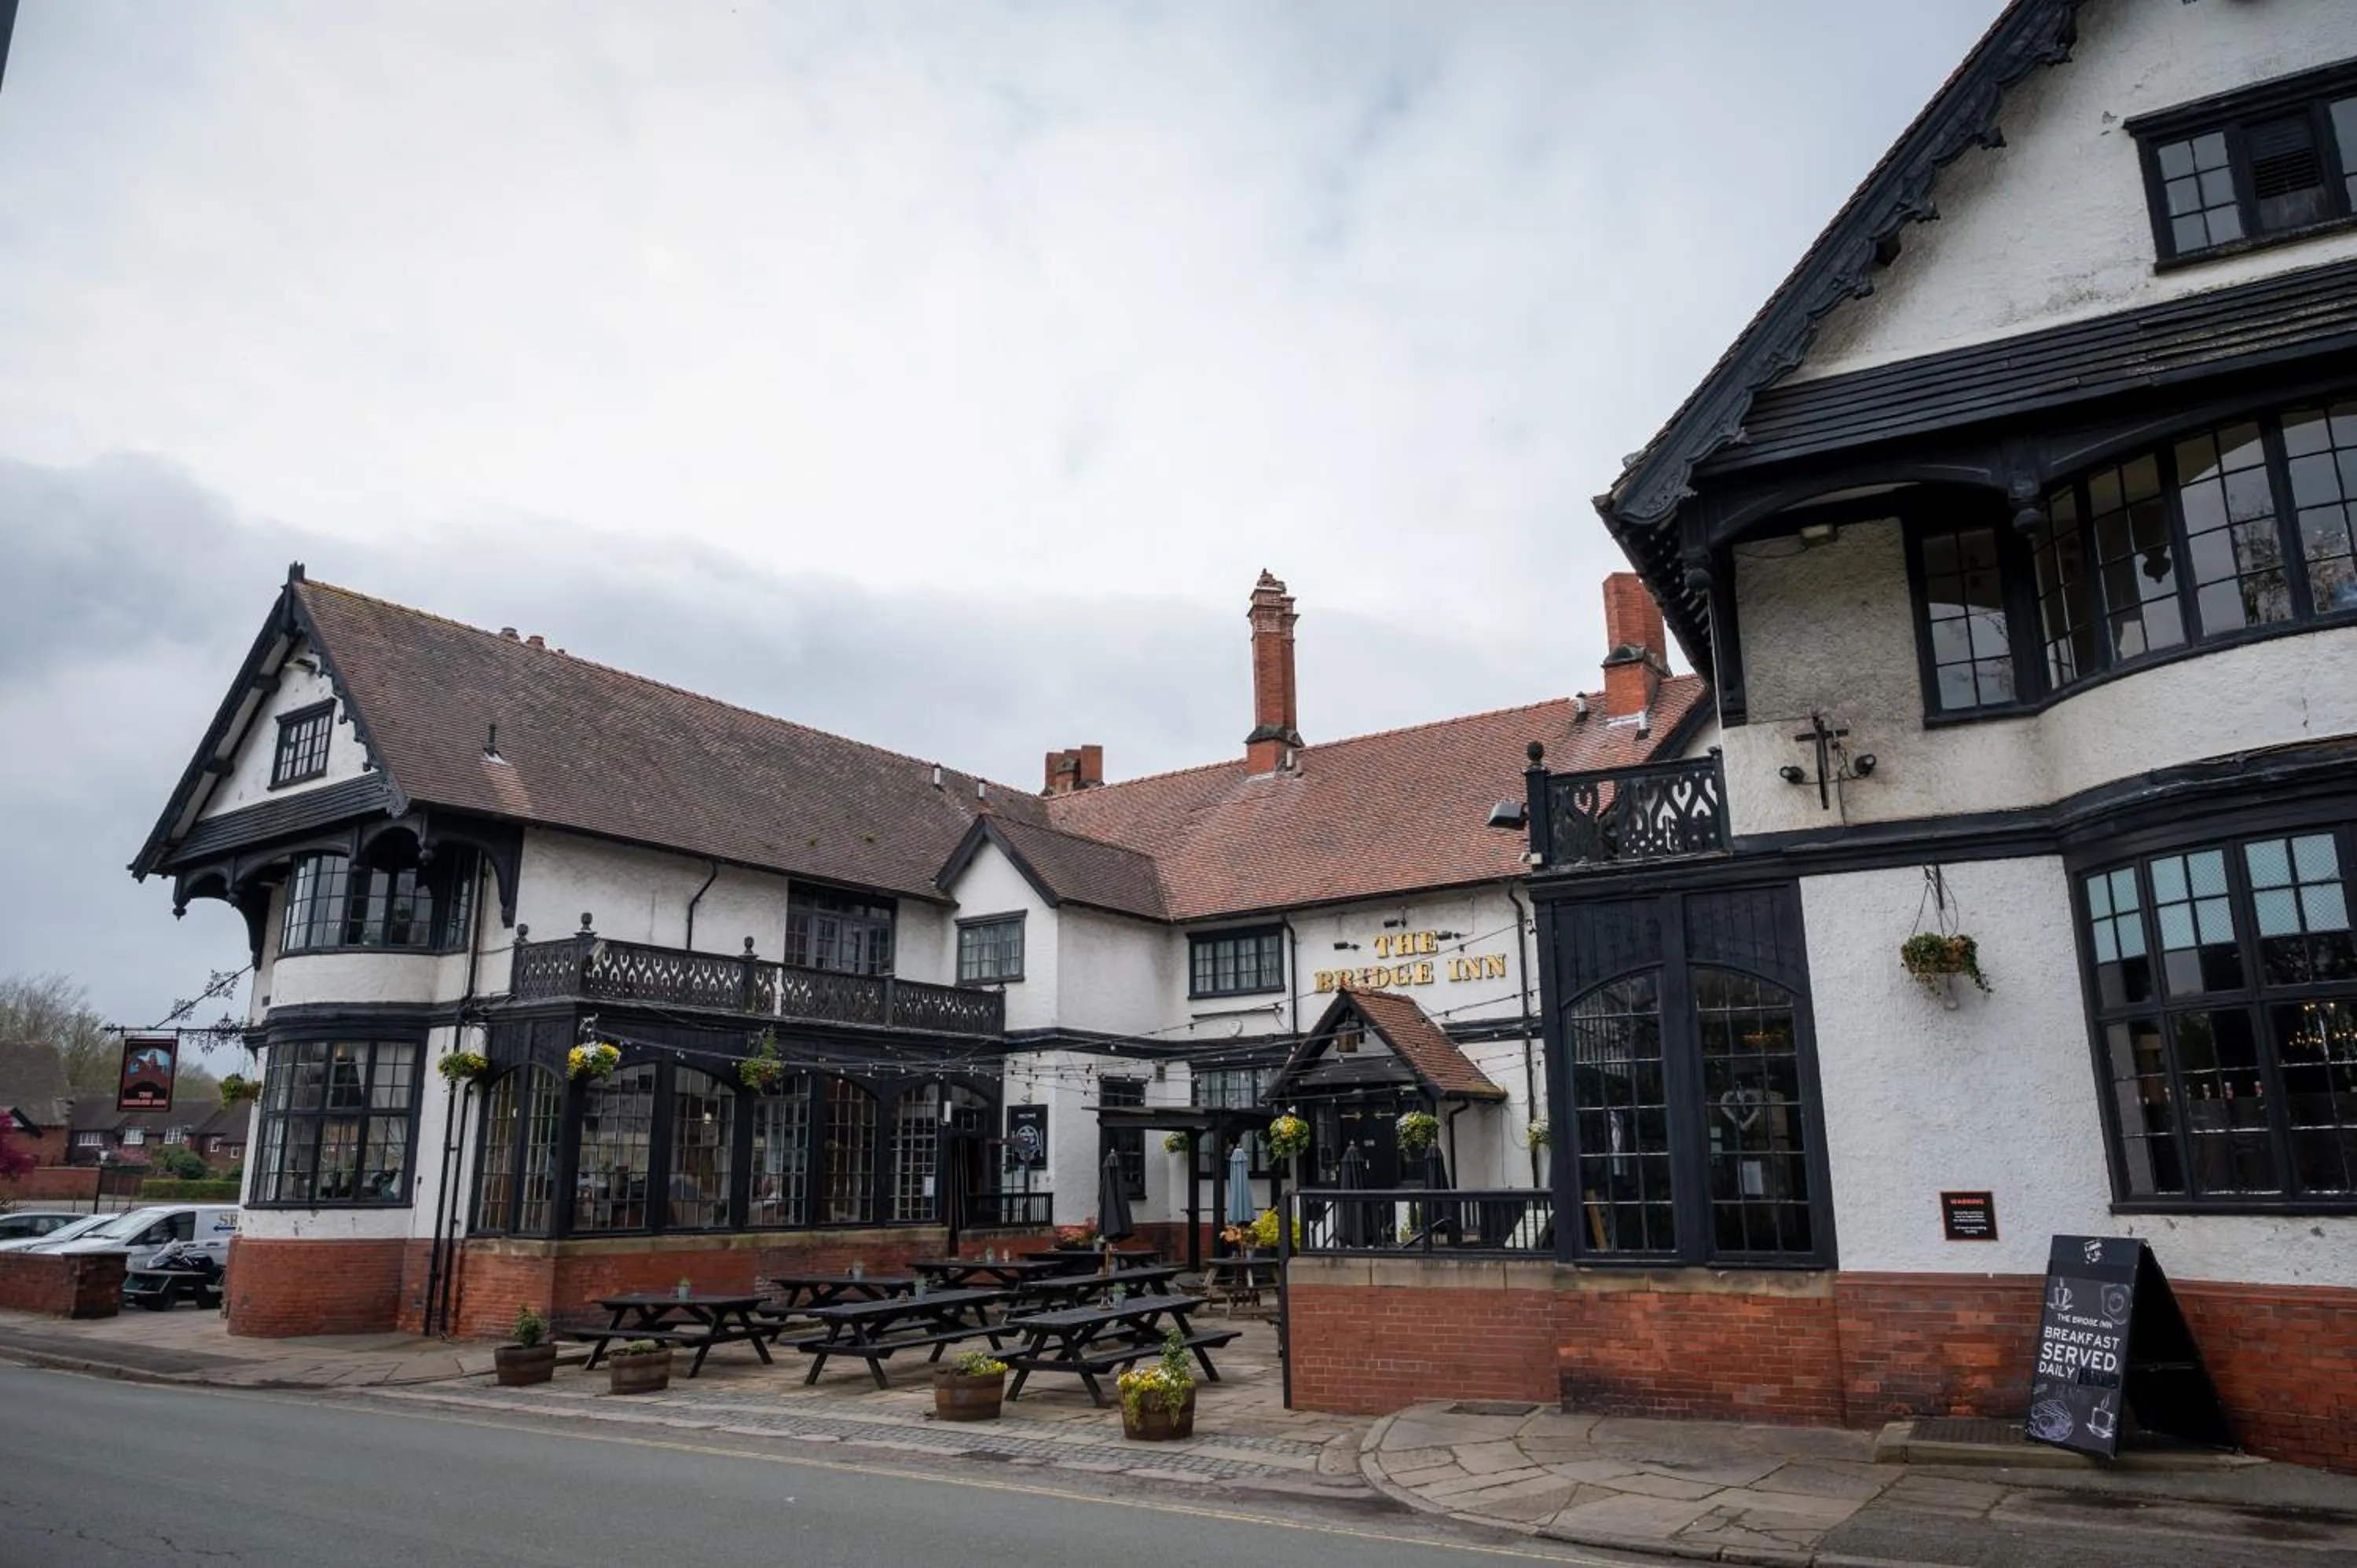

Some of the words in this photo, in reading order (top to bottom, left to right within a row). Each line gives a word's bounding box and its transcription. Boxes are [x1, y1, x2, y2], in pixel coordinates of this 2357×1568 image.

[1374, 930, 1438, 958] THE
[1314, 961, 1435, 994] BRIDGE
[1448, 953, 1507, 982] INN
[2057, 1313, 2072, 1323] THE
[2044, 1325, 2121, 1350] BREAKFAST
[2037, 1361, 2075, 1379] DAILY
[2041, 1342, 2117, 1372] SERVED
